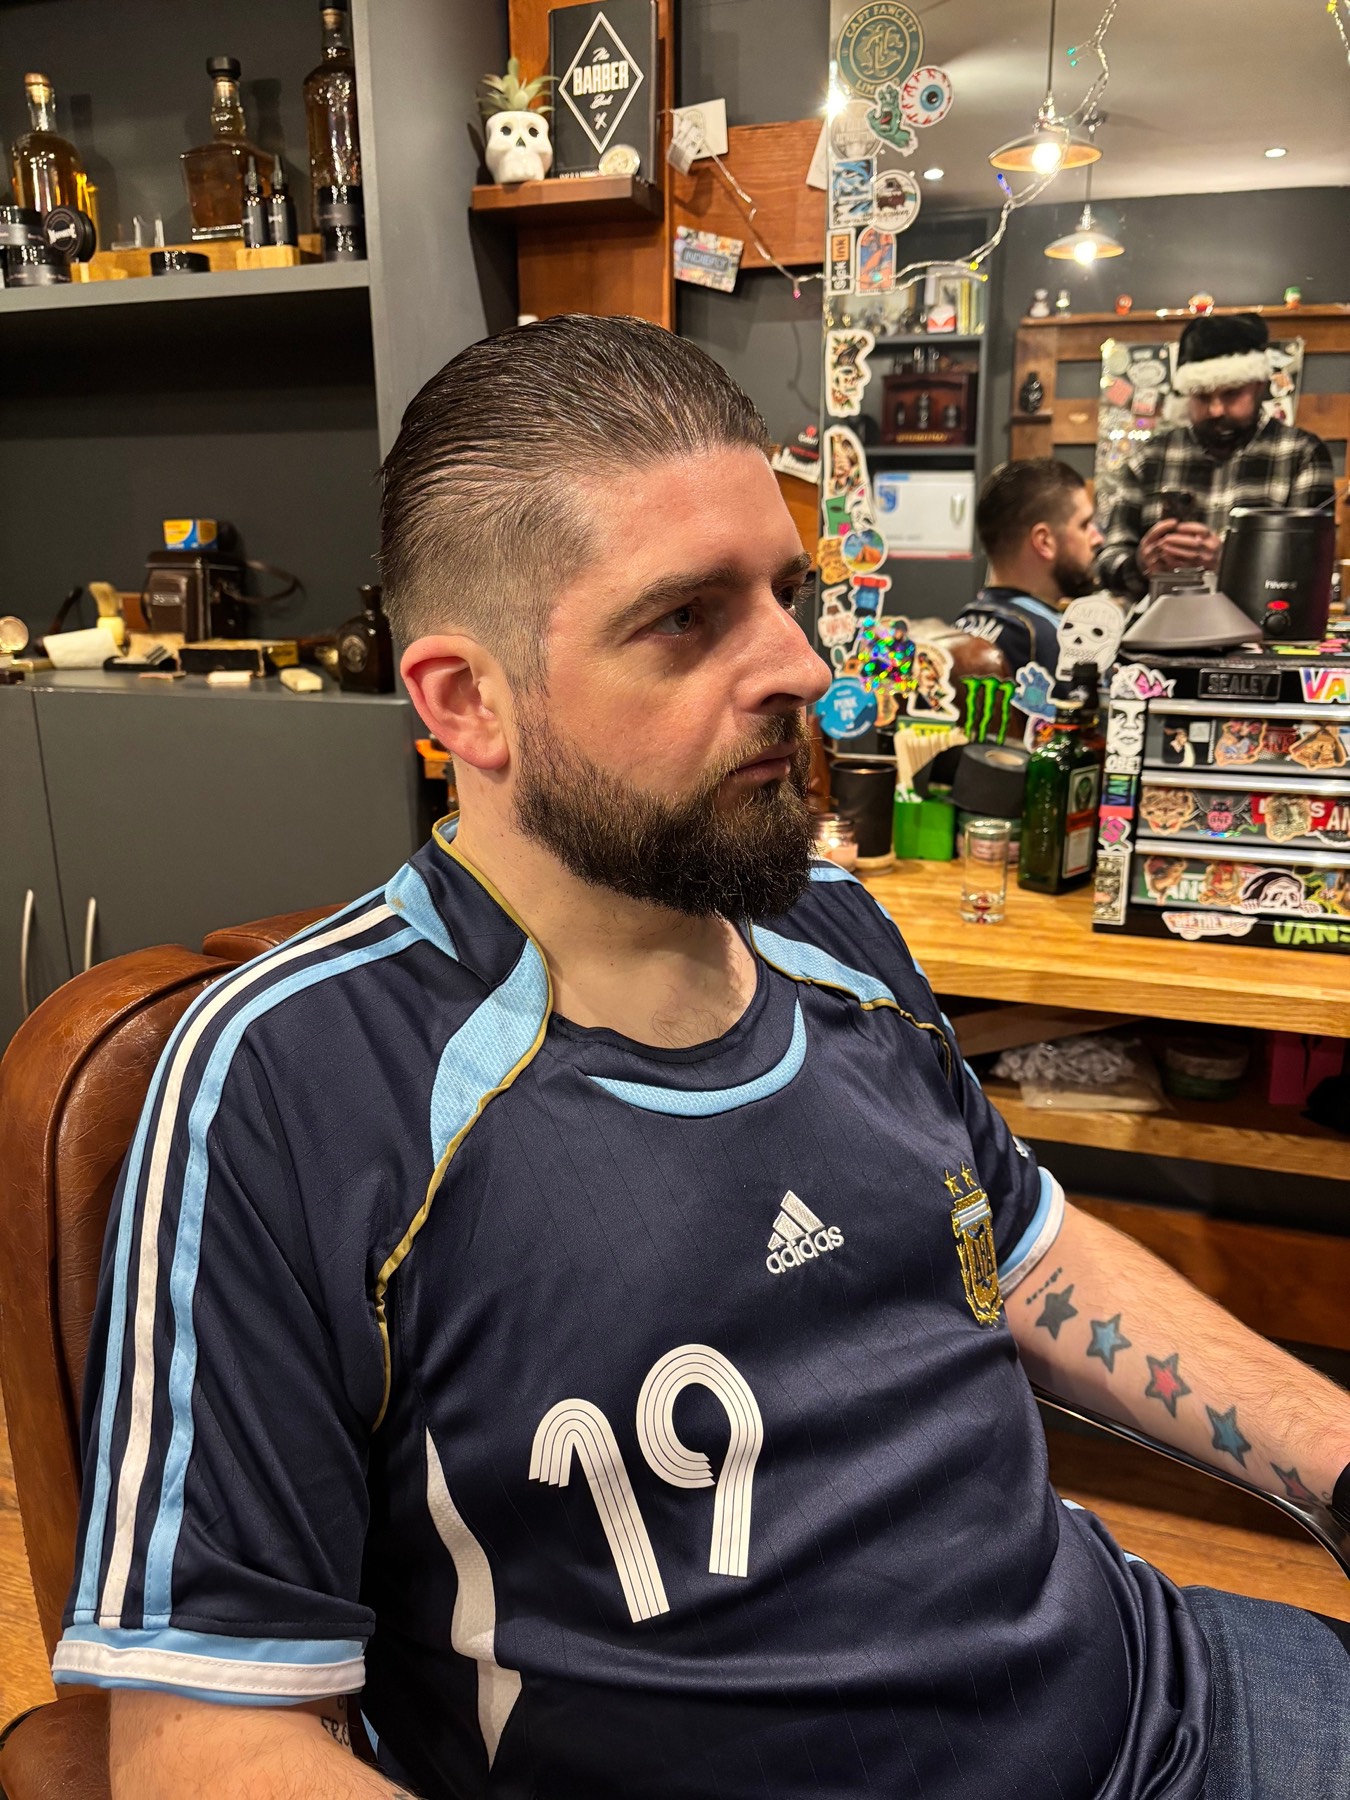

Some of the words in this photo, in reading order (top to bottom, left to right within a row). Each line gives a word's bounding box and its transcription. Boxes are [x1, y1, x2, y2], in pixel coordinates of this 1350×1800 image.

[845, 9, 871, 38] CAPT
[873, 5, 918, 33] FAWCETT
[573, 60, 629, 96] BARBER
[1207, 673, 1272, 695] SEALEY
[766, 1226, 844, 1274] adidas
[529, 1344, 764, 1623] 19
